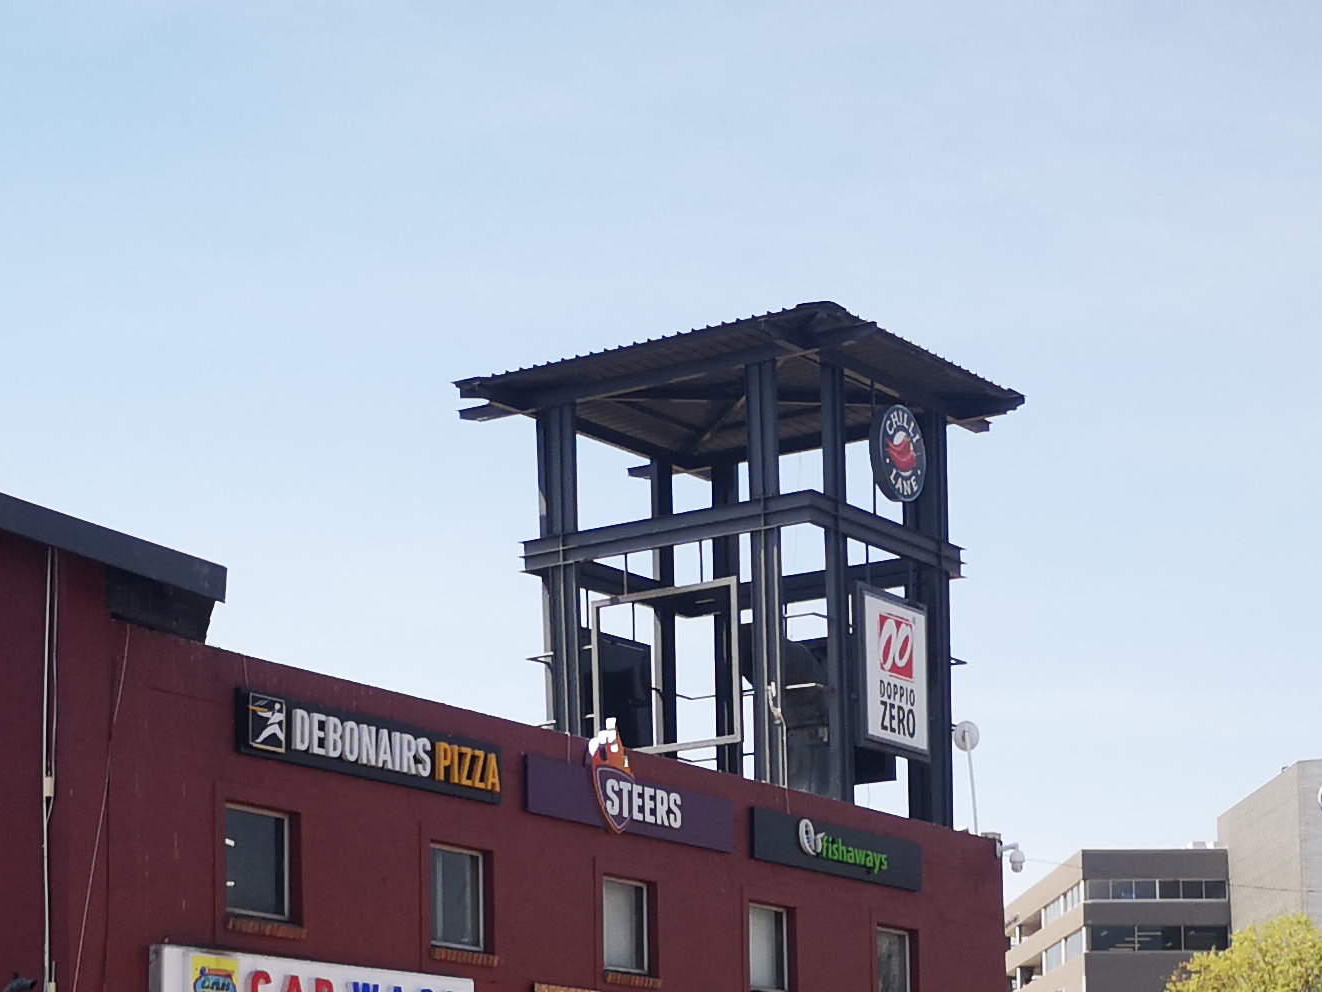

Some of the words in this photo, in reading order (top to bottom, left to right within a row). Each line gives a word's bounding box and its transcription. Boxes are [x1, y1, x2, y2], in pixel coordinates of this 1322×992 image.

[885, 410, 920, 443] CHILLI
[890, 468, 918, 495] LANE
[879, 679, 916, 707] DOPPIO
[880, 700, 916, 738] ZERO
[291, 708, 432, 777] DEBONAIRS
[434, 741, 501, 792] PIZZA
[605, 778, 682, 829] STEERS
[820, 834, 888, 875] fishaways
